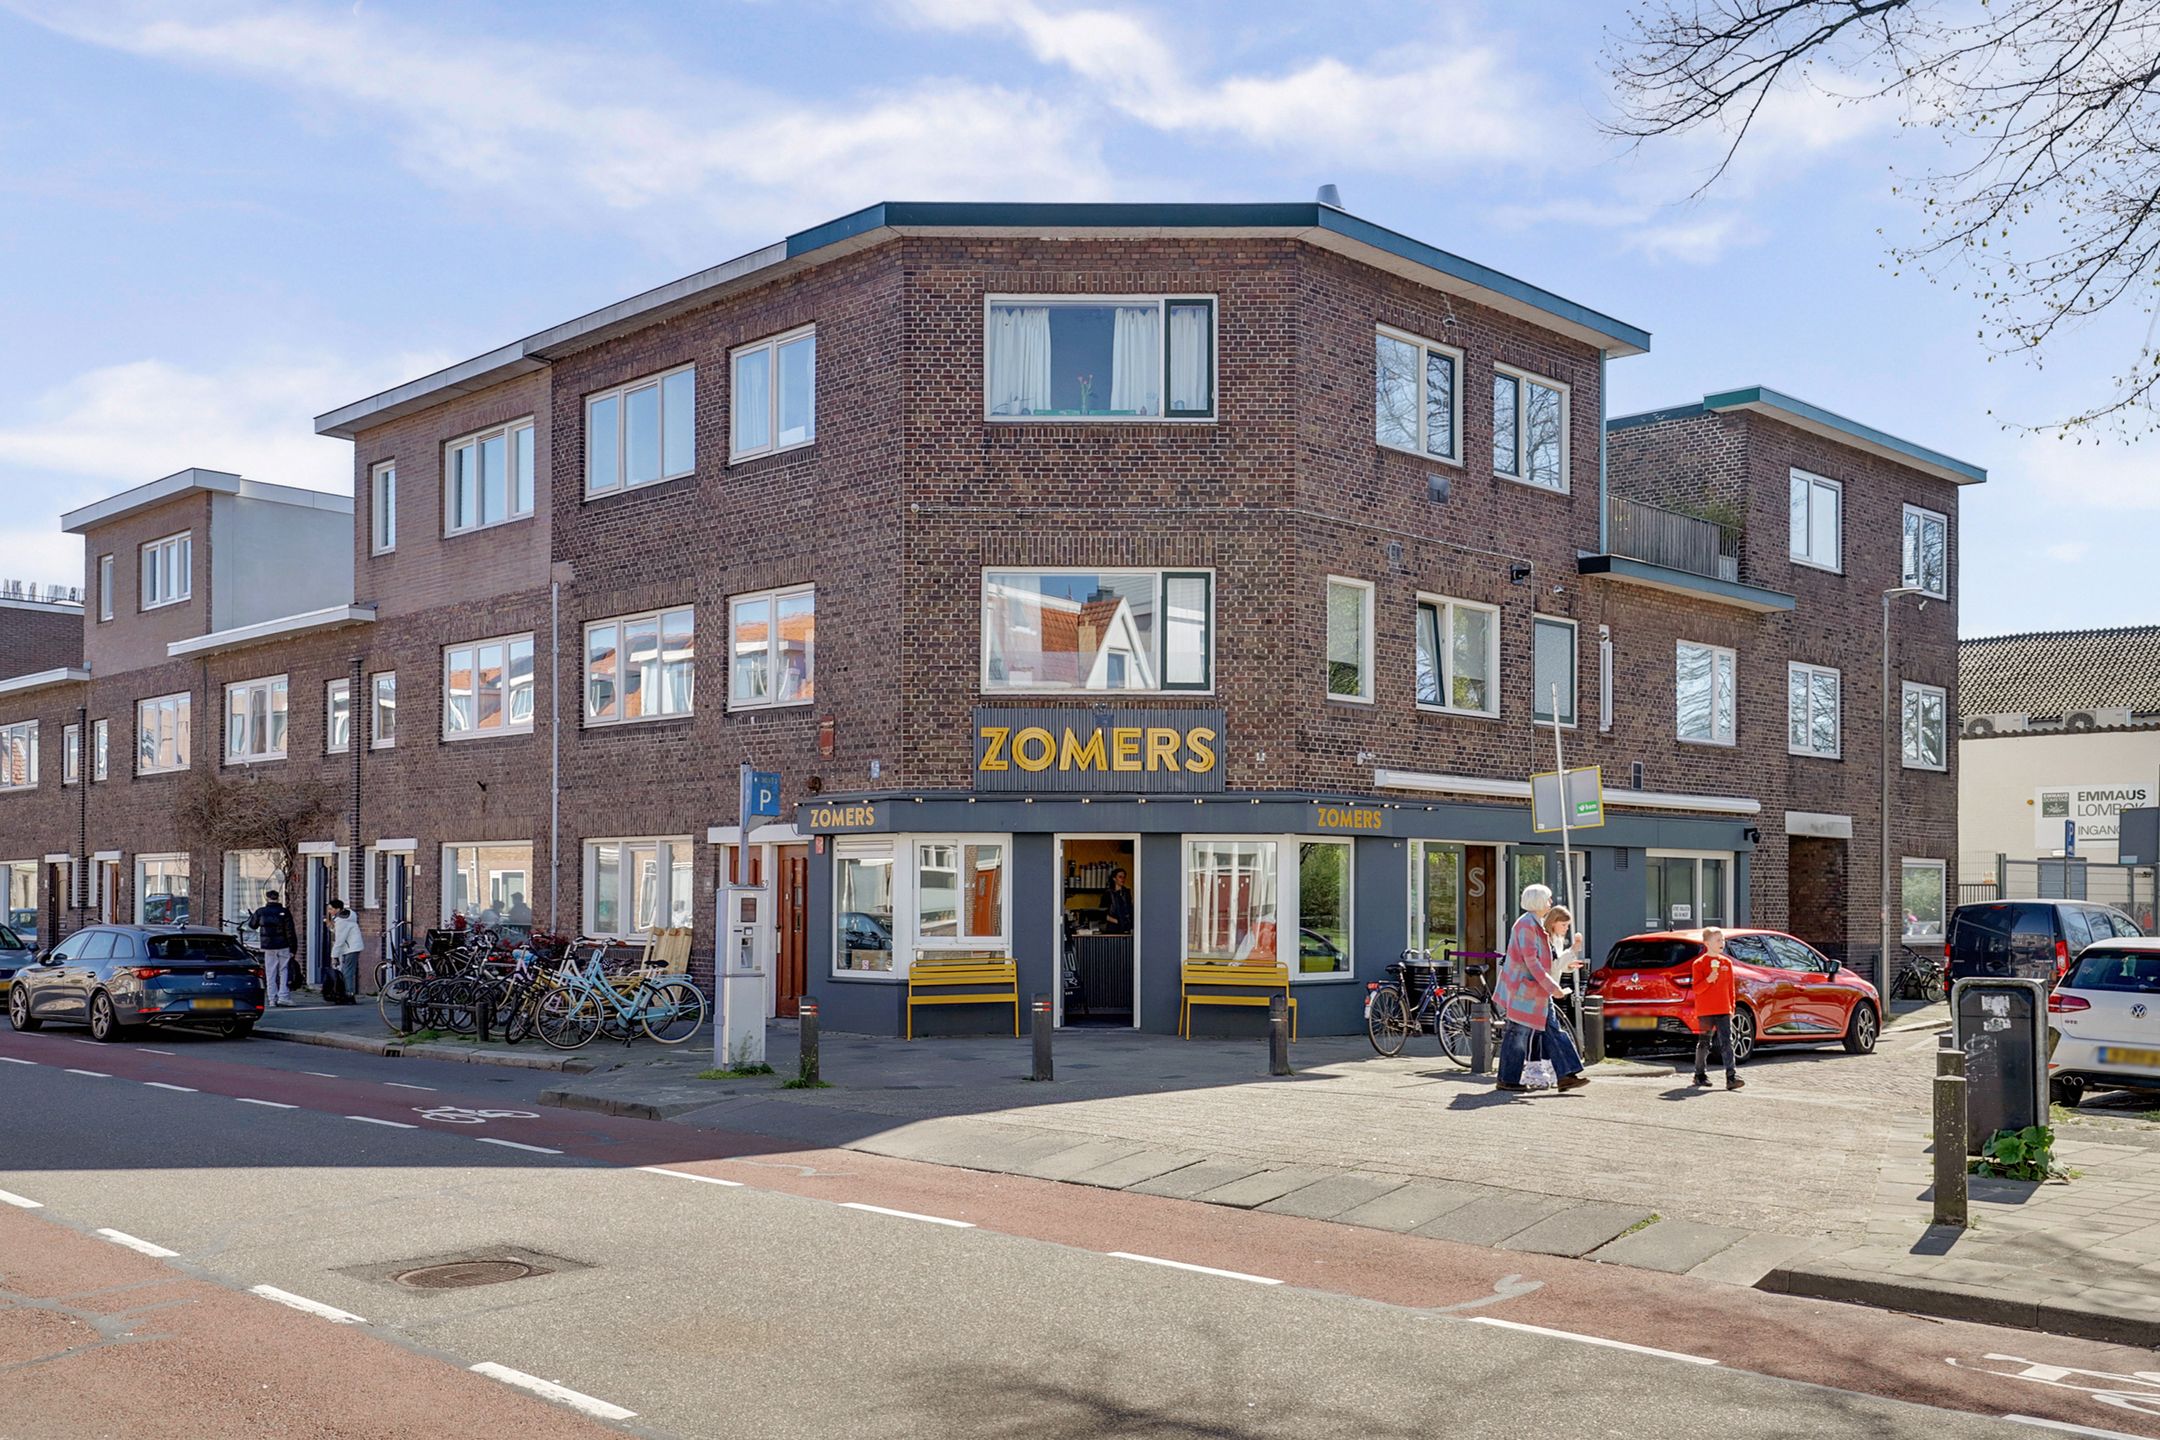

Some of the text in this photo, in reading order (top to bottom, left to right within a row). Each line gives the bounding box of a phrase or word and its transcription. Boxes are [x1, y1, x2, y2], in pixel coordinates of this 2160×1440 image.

[978, 727, 1216, 773] ZOMERS
[760, 789, 772, 811] P
[2078, 789, 2146, 802] EMMAUS
[810, 806, 875, 827] ZOMERS
[1318, 808, 1382, 829] ZOMERS
[1469, 867, 1485, 897] S
